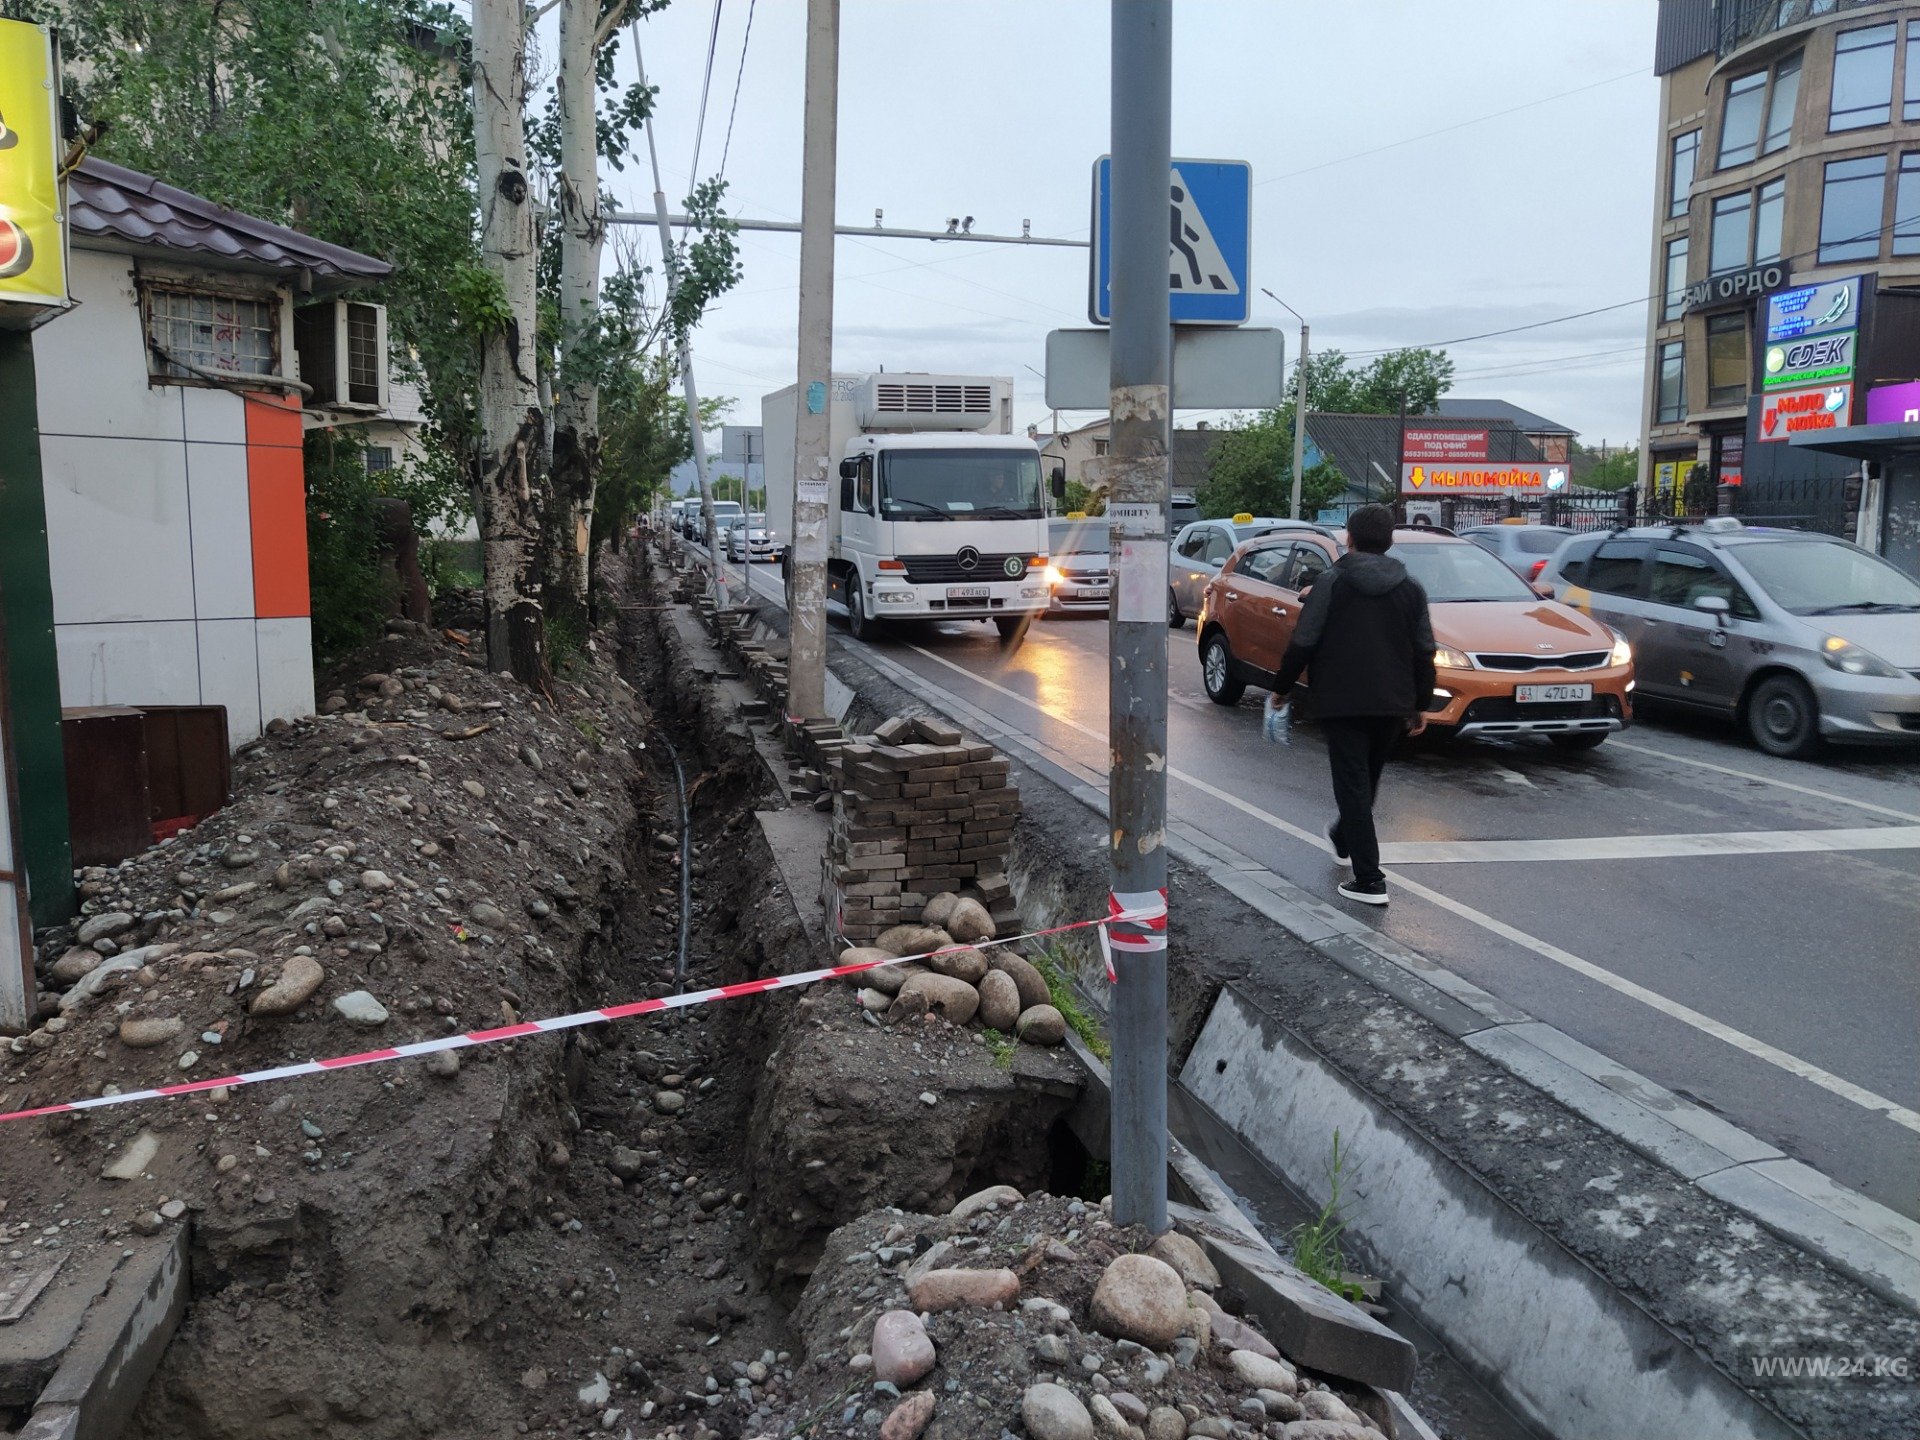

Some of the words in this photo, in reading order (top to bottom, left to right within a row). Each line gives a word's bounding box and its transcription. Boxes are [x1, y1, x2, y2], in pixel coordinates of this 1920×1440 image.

[1685, 279, 1712, 307] БАЙ
[1719, 268, 1782, 297] ОРДО
[1777, 393, 1824, 414] МЫЛО
[1786, 410, 1836, 431] МОЙКА
[1407, 432, 1432, 441] СДАЮ
[1433, 433, 1484, 441] ПОМЕЩЕНИЕ
[1424, 442, 1442, 450] ПОД
[1431, 468, 1541, 487] МЫЛОМОЙКА
[1544, 687, 1568, 699] 470
